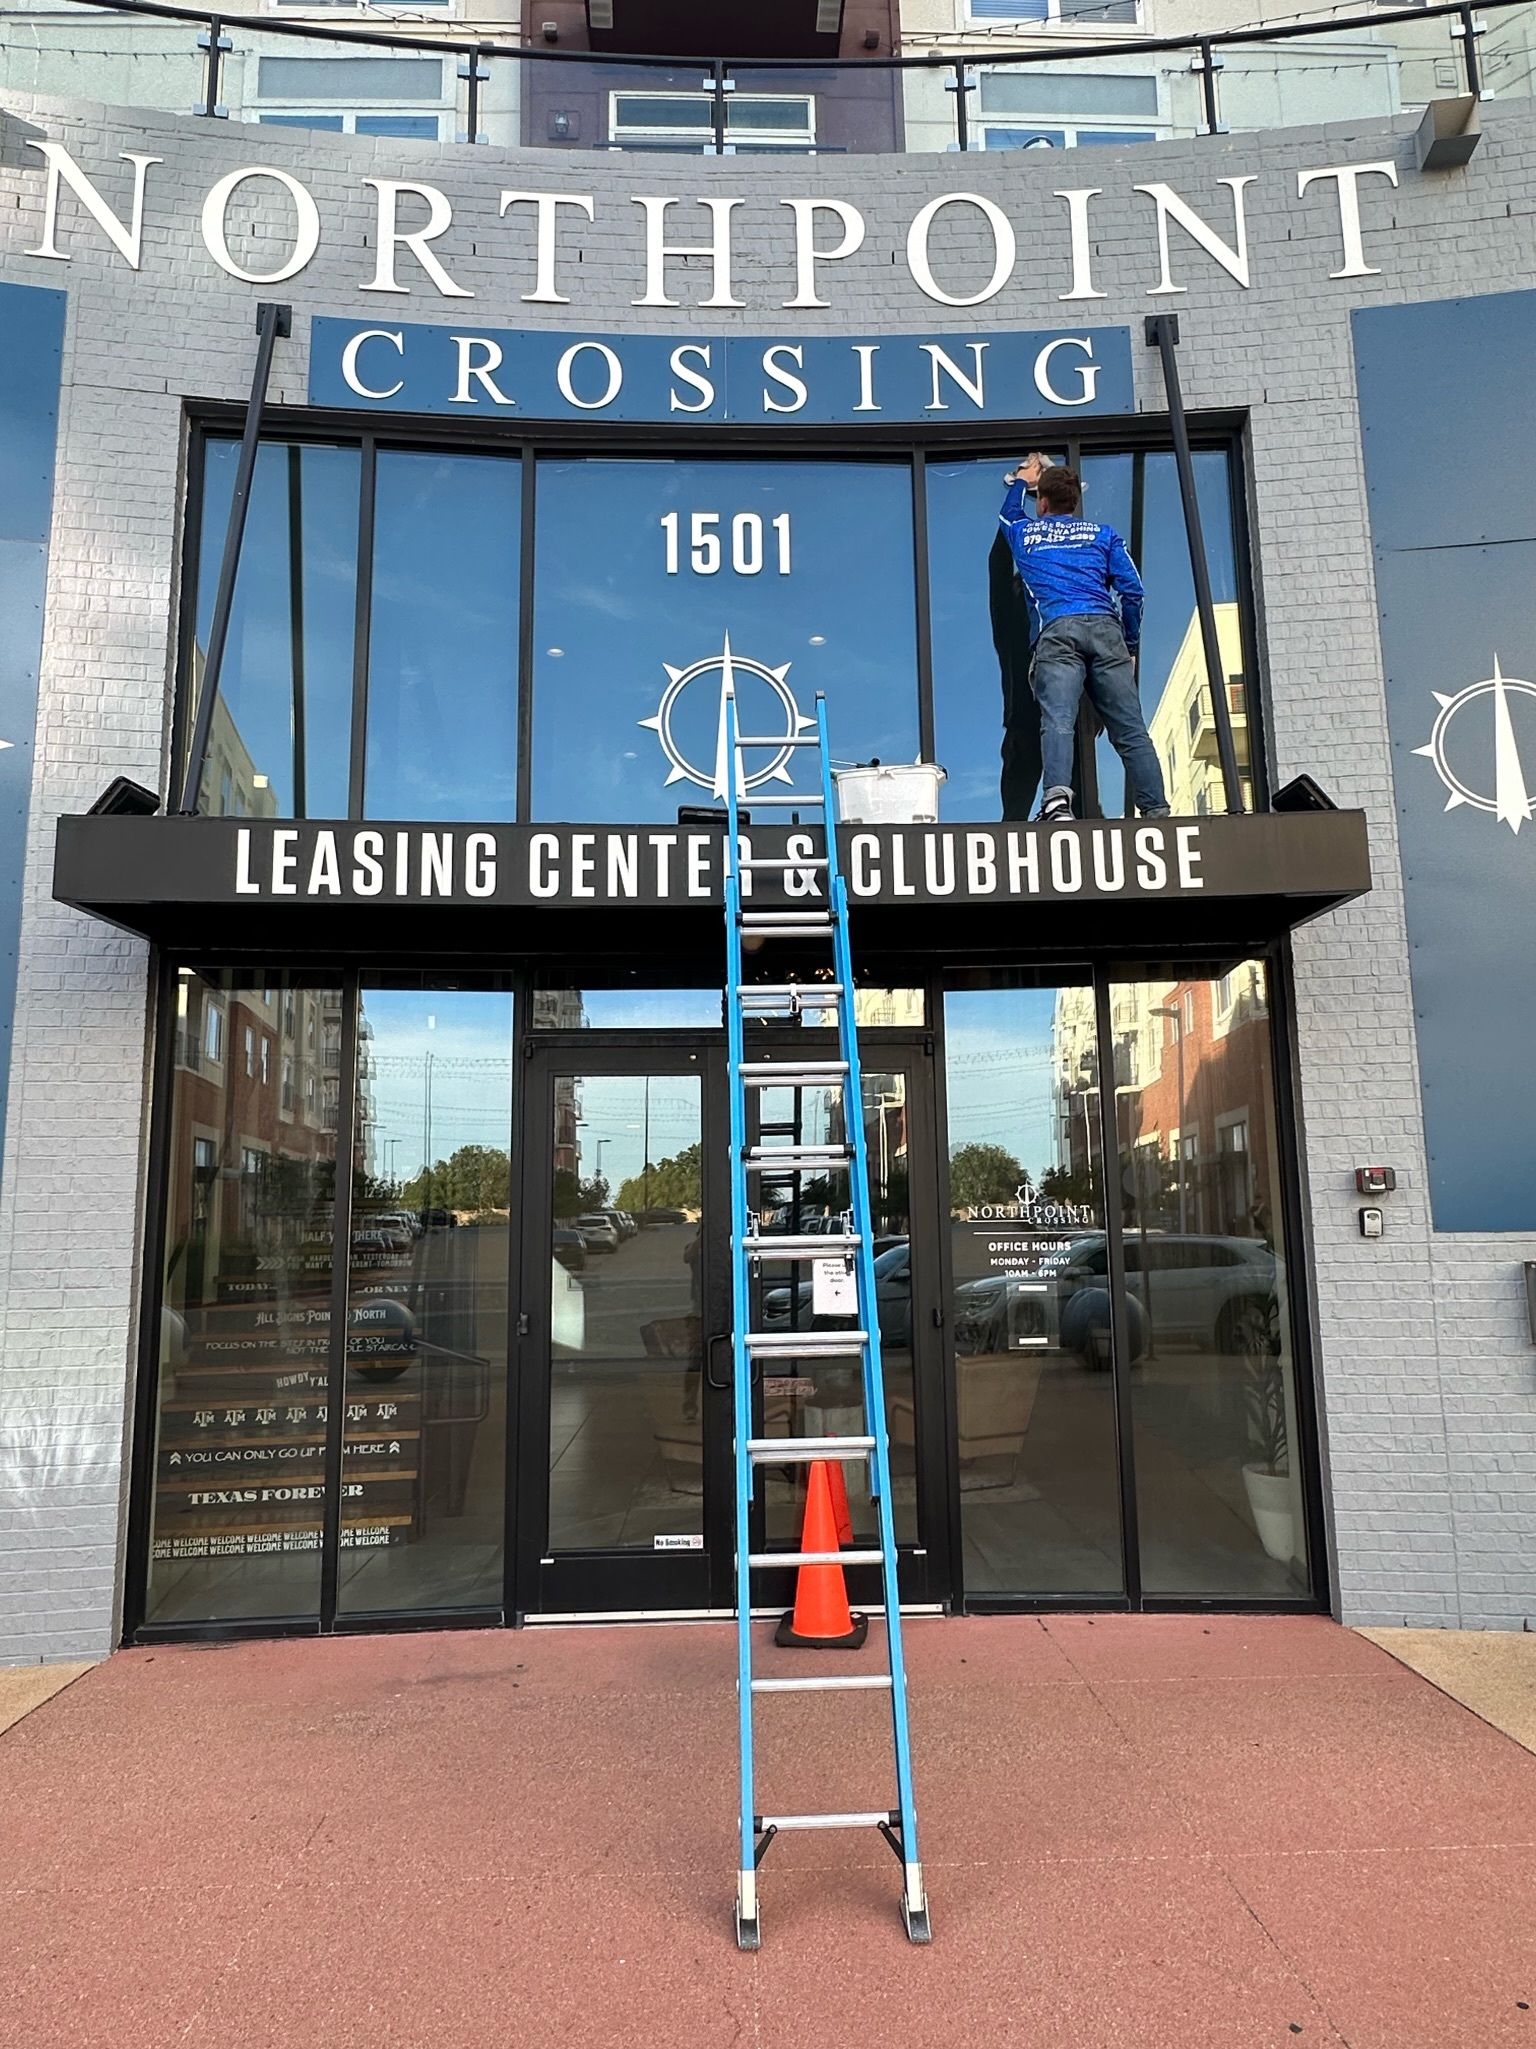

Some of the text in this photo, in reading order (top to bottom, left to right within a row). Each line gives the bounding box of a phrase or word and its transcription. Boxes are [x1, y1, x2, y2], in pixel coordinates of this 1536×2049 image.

[23, 140, 1399, 309] NORTHPOINT
[340, 330, 1102, 413] CROSSING
[660, 512, 791, 575] 1501
[235, 827, 498, 898] LEASING
[783, 834, 823, 897] &
[849, 825, 1205, 897] CLUBHOUSE
[966, 1203, 1091, 1219] NORTHPOINT
[1028, 1216, 1089, 1225] CROSSING
[987, 1240, 1073, 1252] OFFICE HOURS
[990, 1257, 1030, 1267] MONDAY
[1038, 1256, 1072, 1266] FRIDAY
[1005, 1269, 1029, 1278] 10AM
[1037, 1269, 1058, 1278] 6PM
[306, 1309, 331, 1325] POIN
[205, 1341, 240, 1350] FOCUS
[241, 1340, 257, 1349] ON
[348, 1336, 363, 1345] OF
[364, 1336, 385, 1345] YOU
[365, 1343, 419, 1352] STAIRCAE
[185, 1451, 212, 1462] YOU
[214, 1450, 242, 1462] CAN
[243, 1448, 277, 1460] ONLY
[278, 1447, 299, 1459] GO
[299, 1446, 317, 1458] UP
[352, 1443, 387, 1455] HERE
[187, 1489, 258, 1505] TEXAS
[173, 1536, 210, 1548] WELCOME
[210, 1534, 246, 1545] WELCOME
[246, 1531, 283, 1543] WELCOME
[283, 1529, 319, 1541] WELCOME
[355, 1525, 391, 1536] WELCOME
[172, 1545, 209, 1557] WELCOME
[209, 1543, 246, 1555] WELCOME
[246, 1541, 282, 1553] WELCOME
[282, 1539, 319, 1551] WELCOME
[355, 1535, 390, 1546] WELCOME
